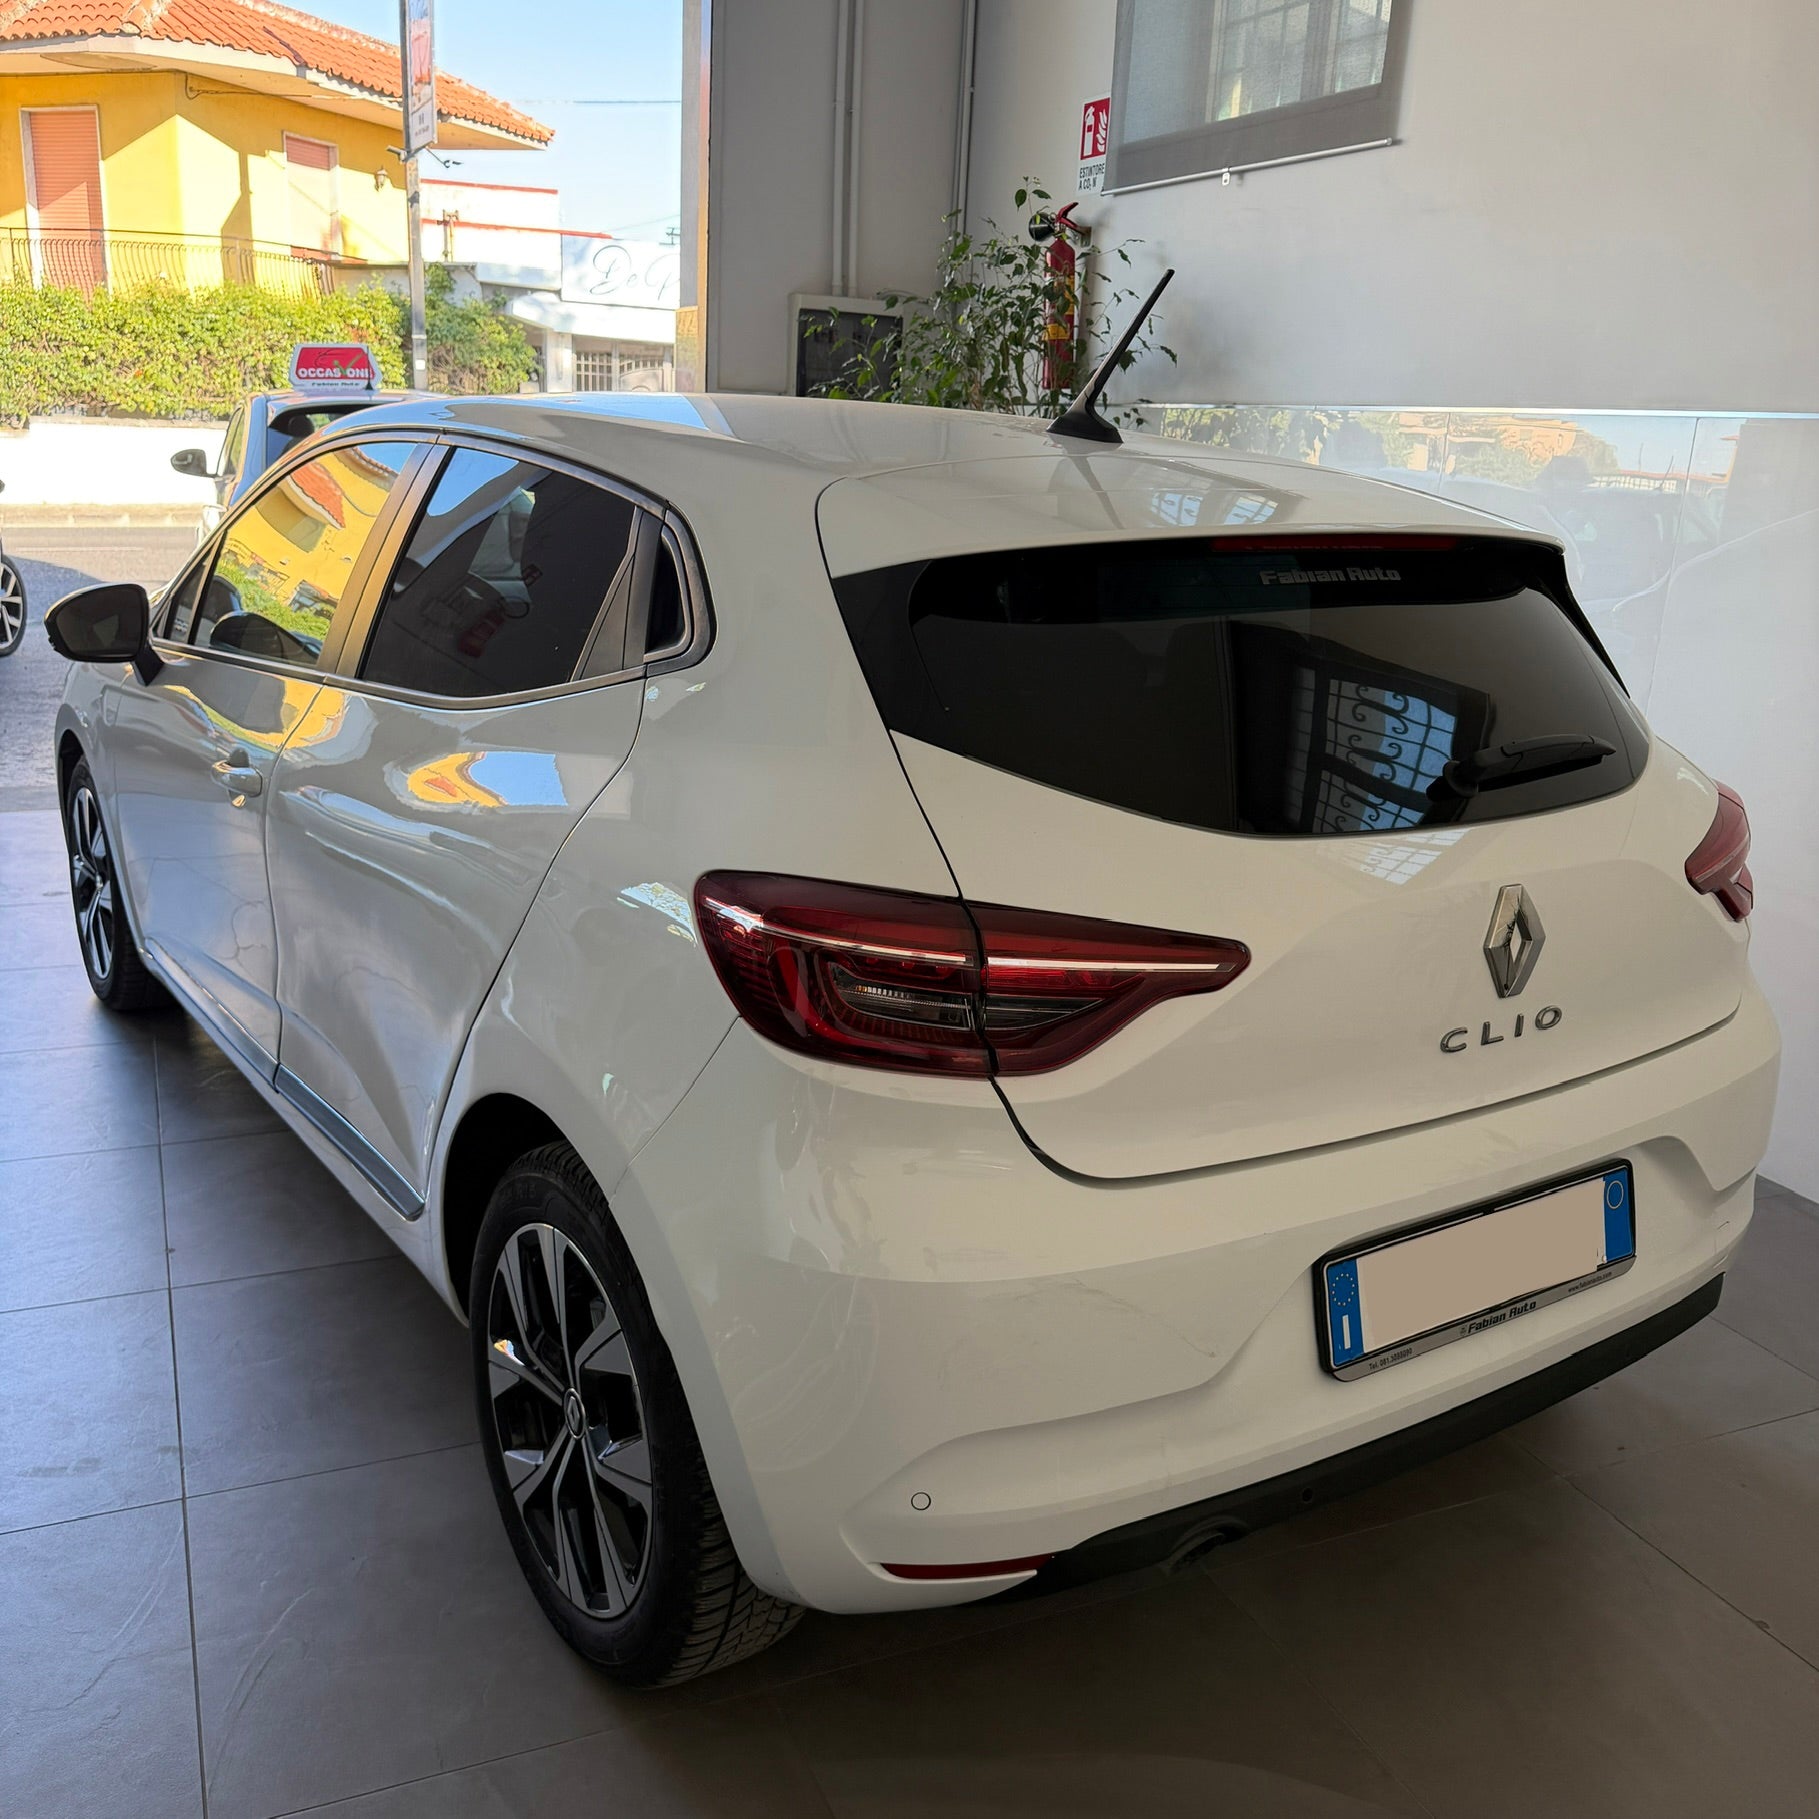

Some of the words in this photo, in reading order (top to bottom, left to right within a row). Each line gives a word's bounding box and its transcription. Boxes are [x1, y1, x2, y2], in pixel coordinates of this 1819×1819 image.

[1080, 163, 1105, 178] ESTINTORE
[1078, 180, 1082, 190] A
[1259, 568, 1346, 585] Fabian
[1346, 567, 1401, 582] Auto
[1439, 1004, 1563, 1053] CLIO
[1467, 1313, 1506, 1334] Fabian
[1509, 1301, 1537, 1318] Auto
